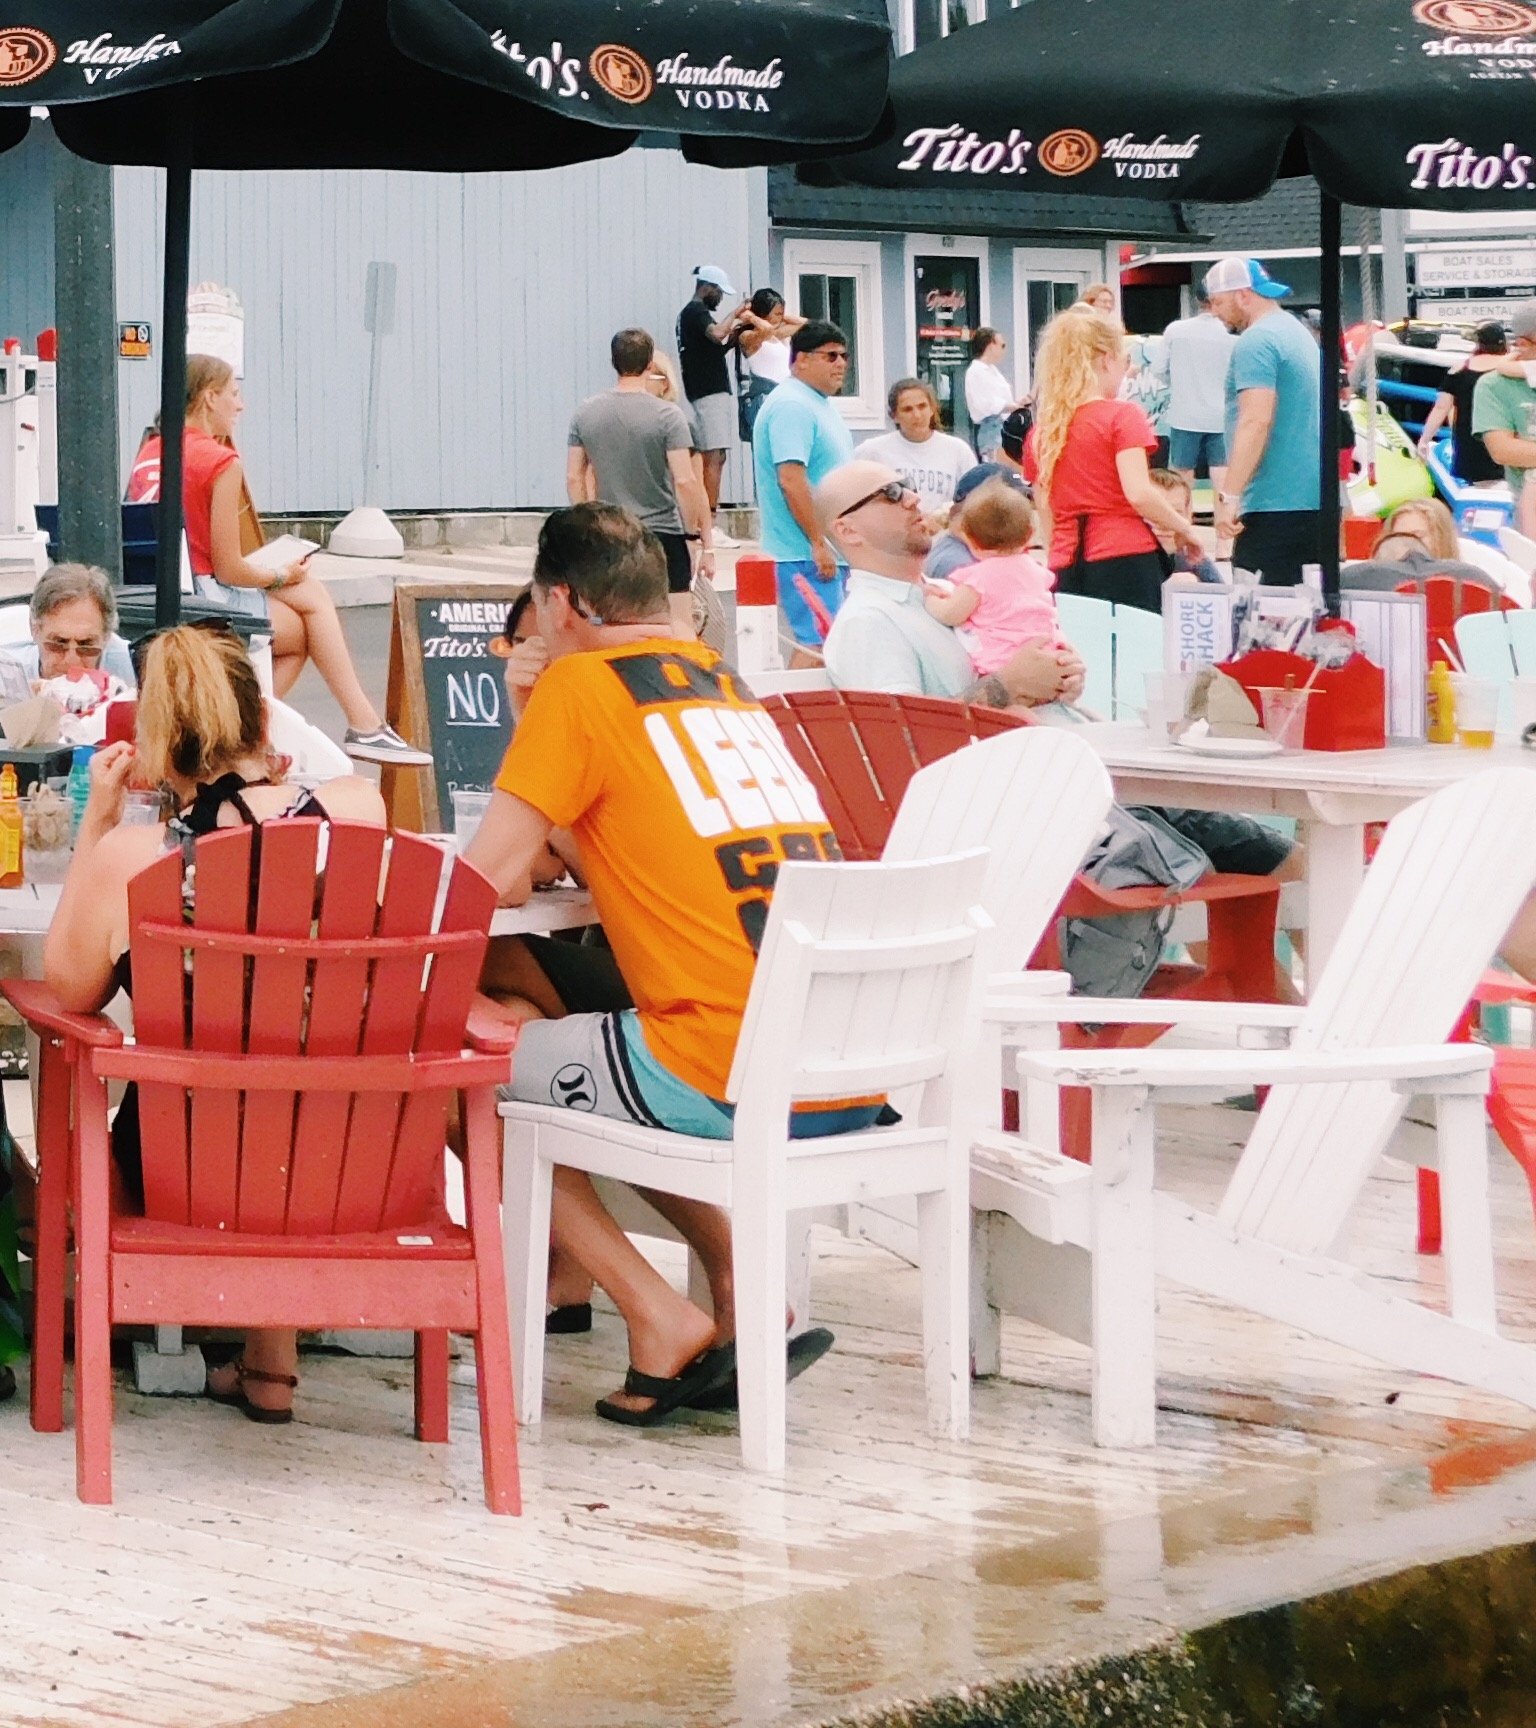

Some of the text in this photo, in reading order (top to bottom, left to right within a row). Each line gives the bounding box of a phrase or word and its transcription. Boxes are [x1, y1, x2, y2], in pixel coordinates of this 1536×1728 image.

[656, 52, 785, 88] Handmade
[675, 89, 771, 113] VODKA
[1101, 132, 1203, 159] Handmade
[1114, 162, 1180, 179] VODKA
[1443, 255, 1513, 267] BOAT SALES
[1422, 270, 1469, 282] SERVICE
[1438, 306, 1468, 317] BOAT
[448, 623, 487, 633] ORIGINAL
[1180, 600, 1195, 660] SHORE
[446, 670, 500, 723] NO
